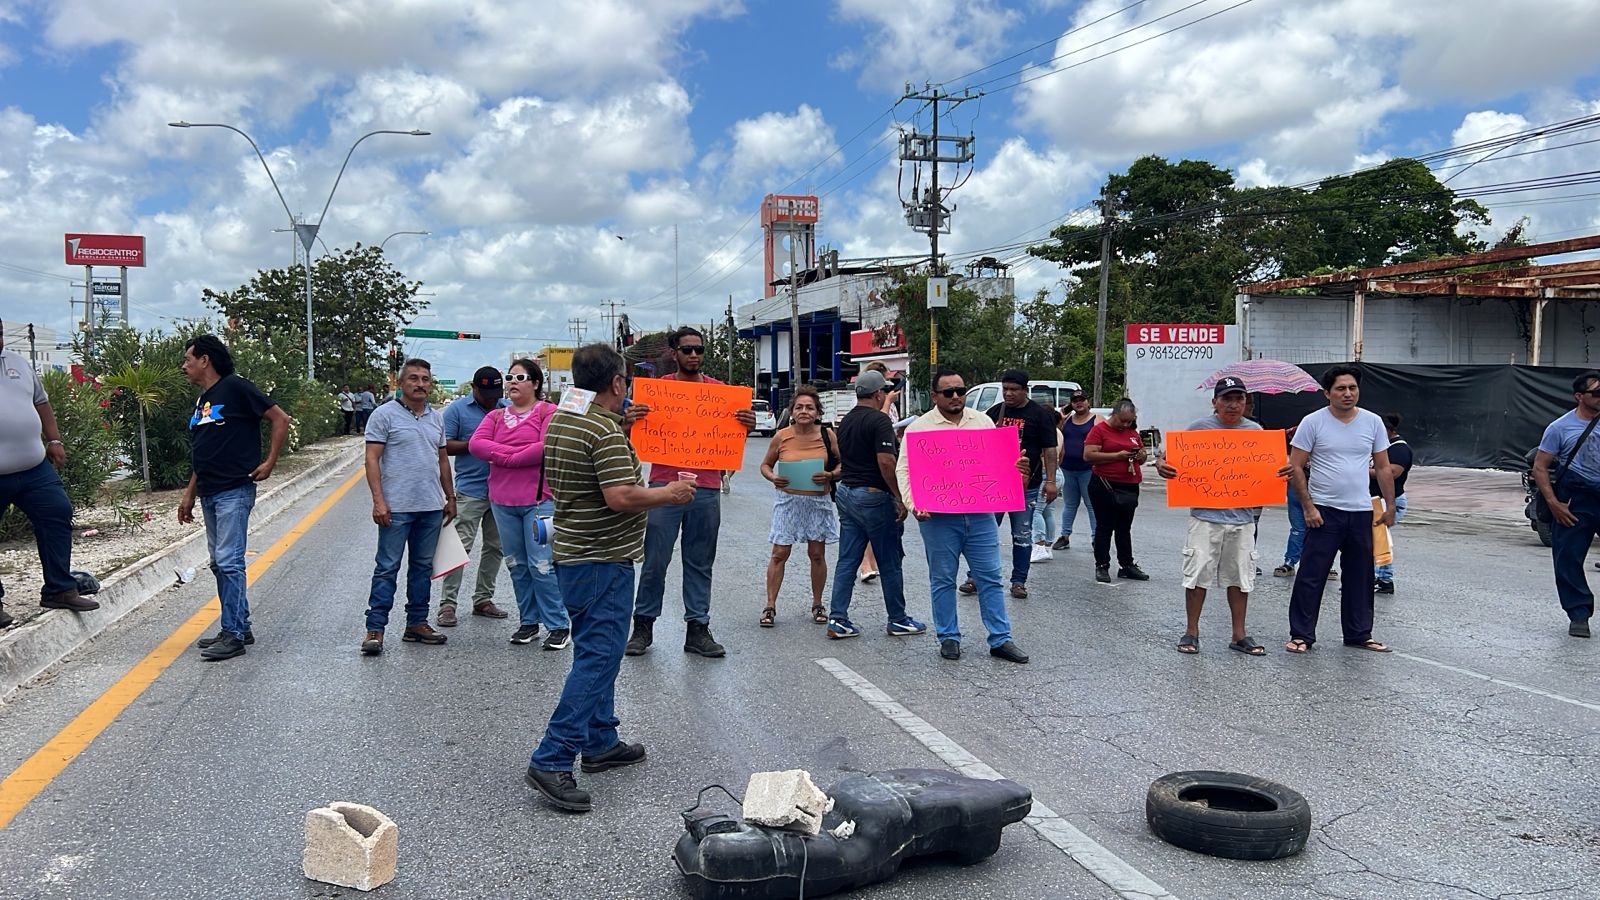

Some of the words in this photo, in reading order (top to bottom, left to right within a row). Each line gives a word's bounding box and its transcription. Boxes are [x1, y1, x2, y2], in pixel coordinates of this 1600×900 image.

[778, 199, 816, 217] MOTEL
[78, 248, 138, 257] REGIOCENTRO
[1140, 328, 1160, 342] SE
[1168, 328, 1218, 342] VENDE
[1149, 346, 1213, 360] 9843229990
[682, 424, 697, 438] de
[1213, 437, 1237, 450] robo
[936, 491, 976, 507] Robo
